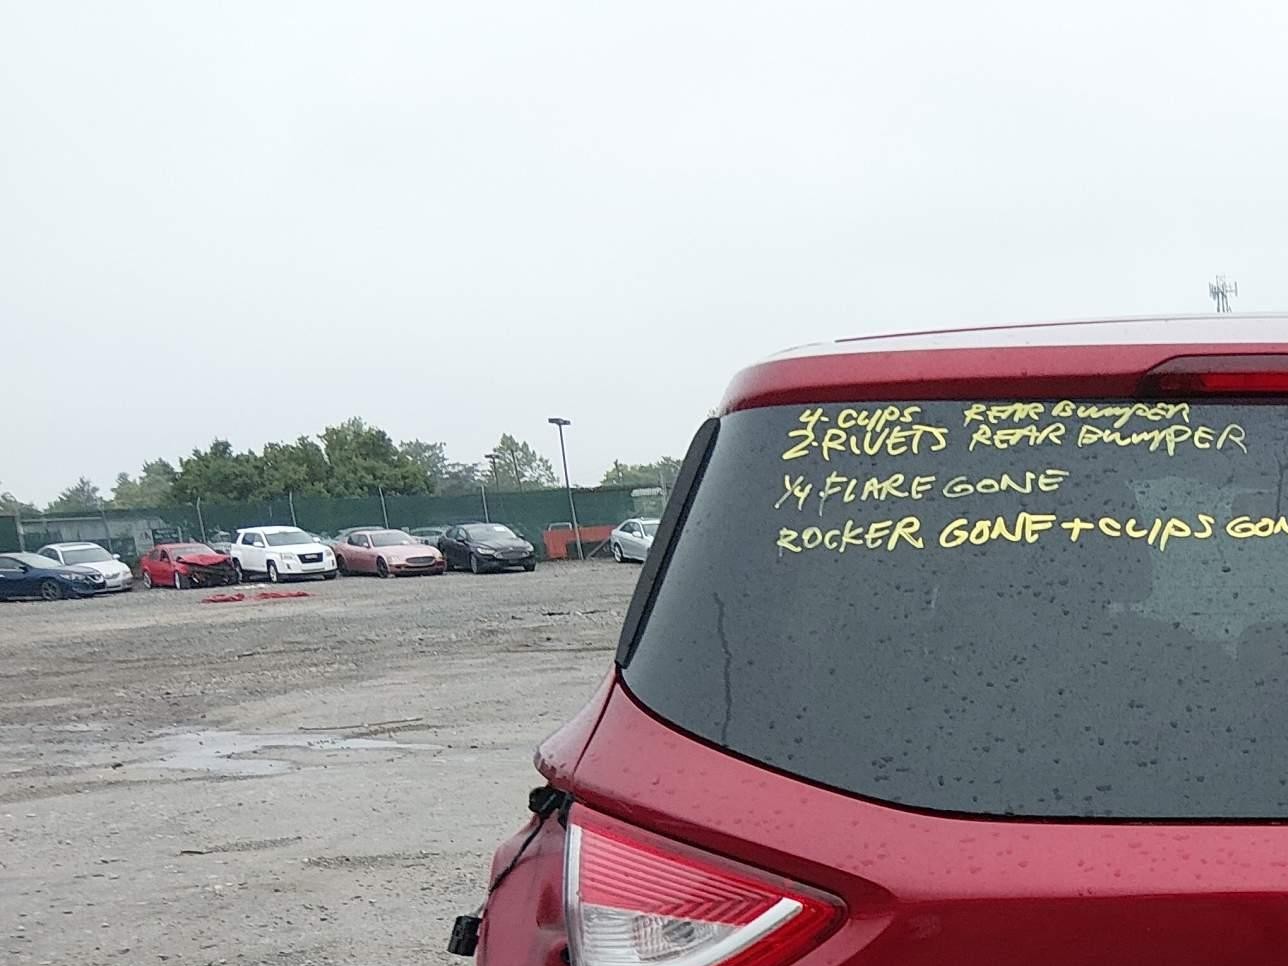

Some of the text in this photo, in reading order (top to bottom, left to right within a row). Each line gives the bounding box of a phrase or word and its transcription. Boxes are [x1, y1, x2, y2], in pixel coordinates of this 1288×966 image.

[962, 402, 1045, 428] REAR
[968, 423, 1066, 451] REAR
[818, 471, 935, 516] FLARE
[943, 468, 1070, 498] GONE
[775, 516, 925, 558] ROCKER
[938, 512, 1057, 547] GONE
[1099, 514, 1215, 552] CLIPS
